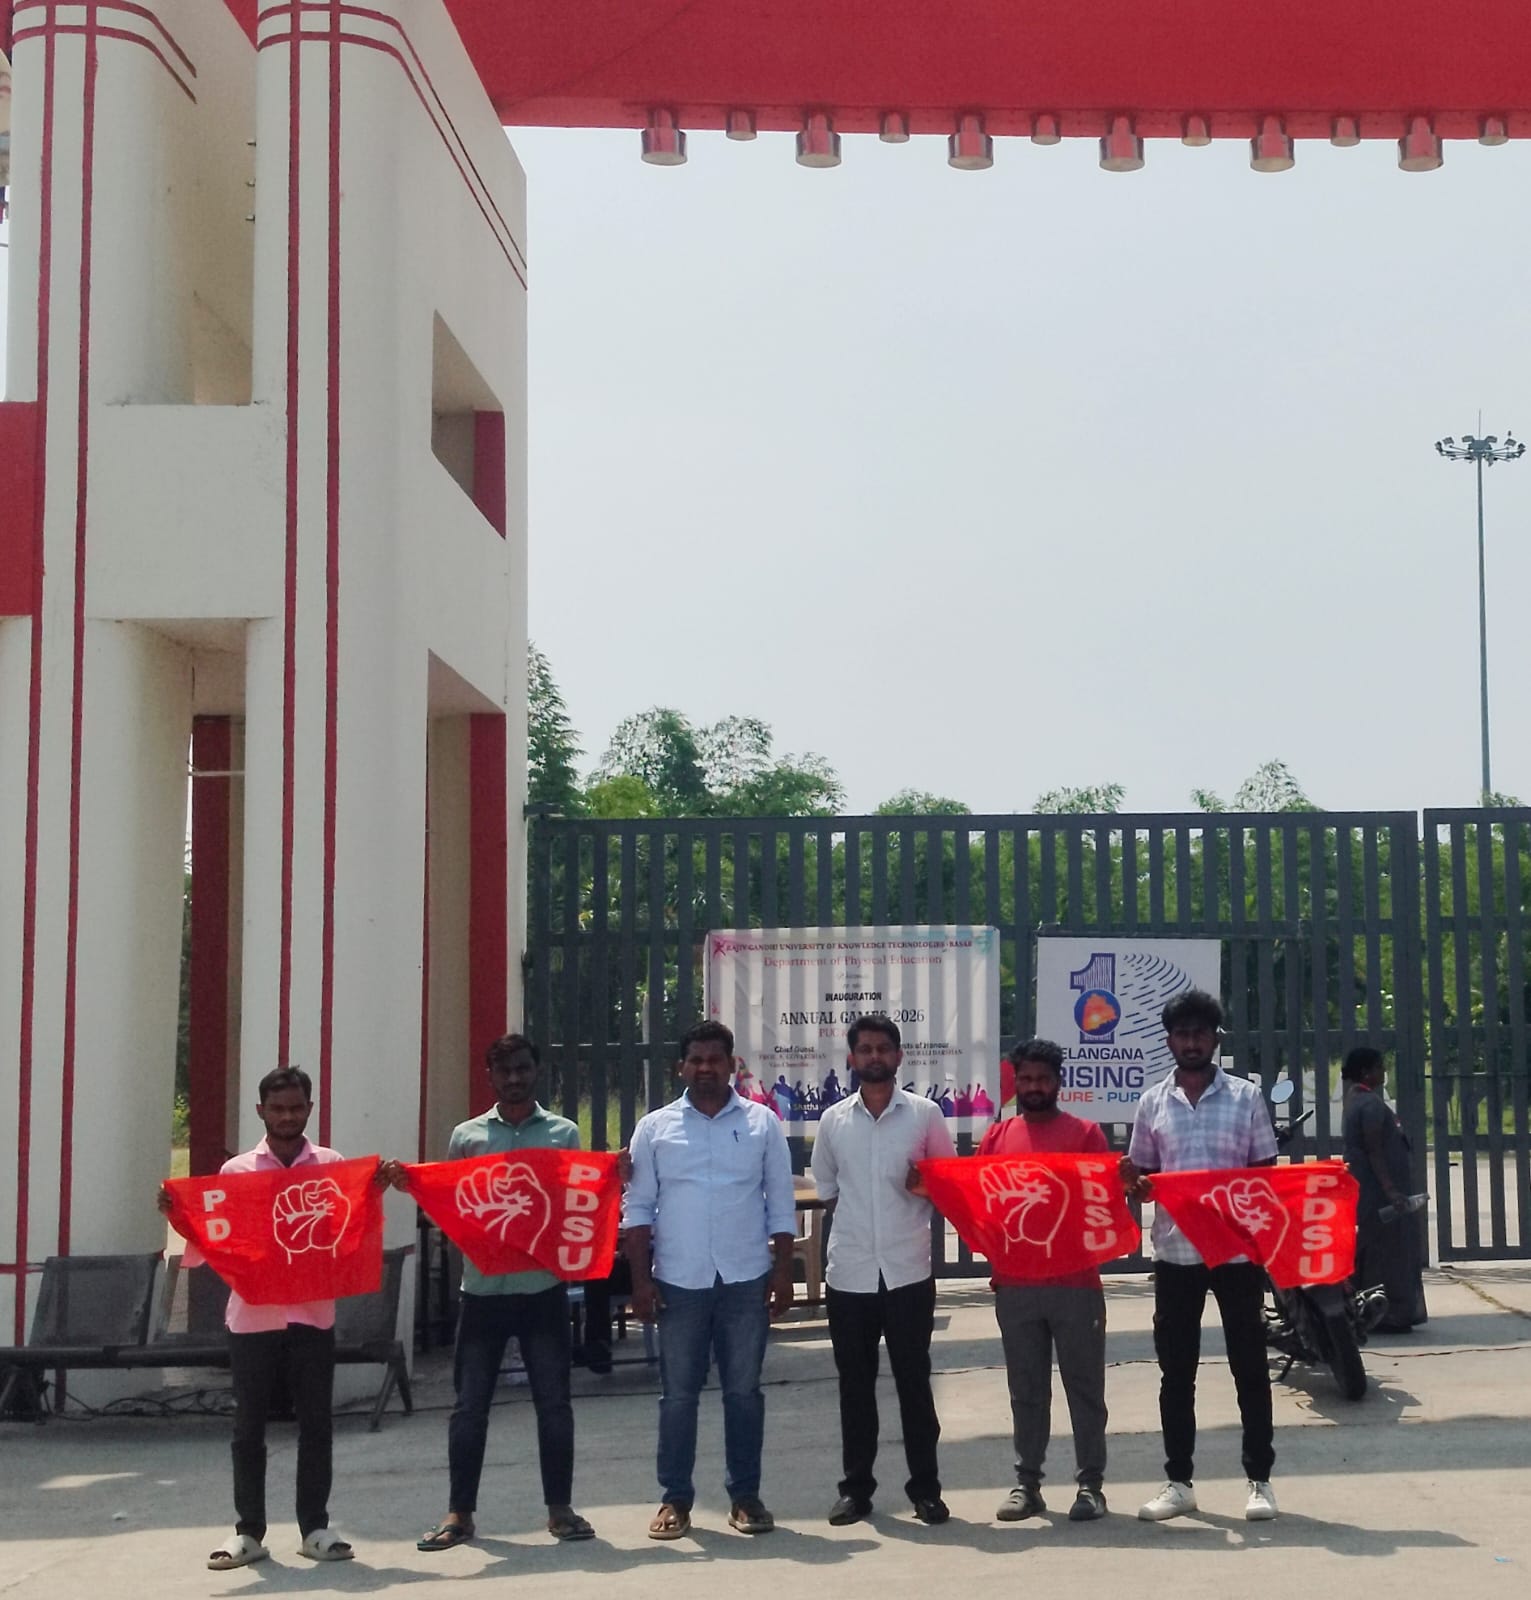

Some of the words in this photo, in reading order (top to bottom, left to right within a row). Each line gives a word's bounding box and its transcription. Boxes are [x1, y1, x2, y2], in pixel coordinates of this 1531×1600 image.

[780, 943, 824, 951] UNIVERSITY
[826, 942, 835, 950] OF
[838, 941, 885, 950] KNOWLEDGE
[764, 956, 826, 968] Department
[831, 956, 841, 966] of
[845, 954, 887, 968] Physical
[890, 954, 942, 965] Education
[825, 992, 882, 1002] INAUGURATION
[780, 1011, 838, 1025] ANNUAL
[1061, 1048, 1144, 1060] ELANGANA
[1058, 1091, 1094, 1102] URE
[1107, 1091, 1141, 1103] PUR
[1076, 1161, 1117, 1251] PDSU
[558, 1163, 601, 1271] PDSU
[1299, 1174, 1339, 1278] PDSU
